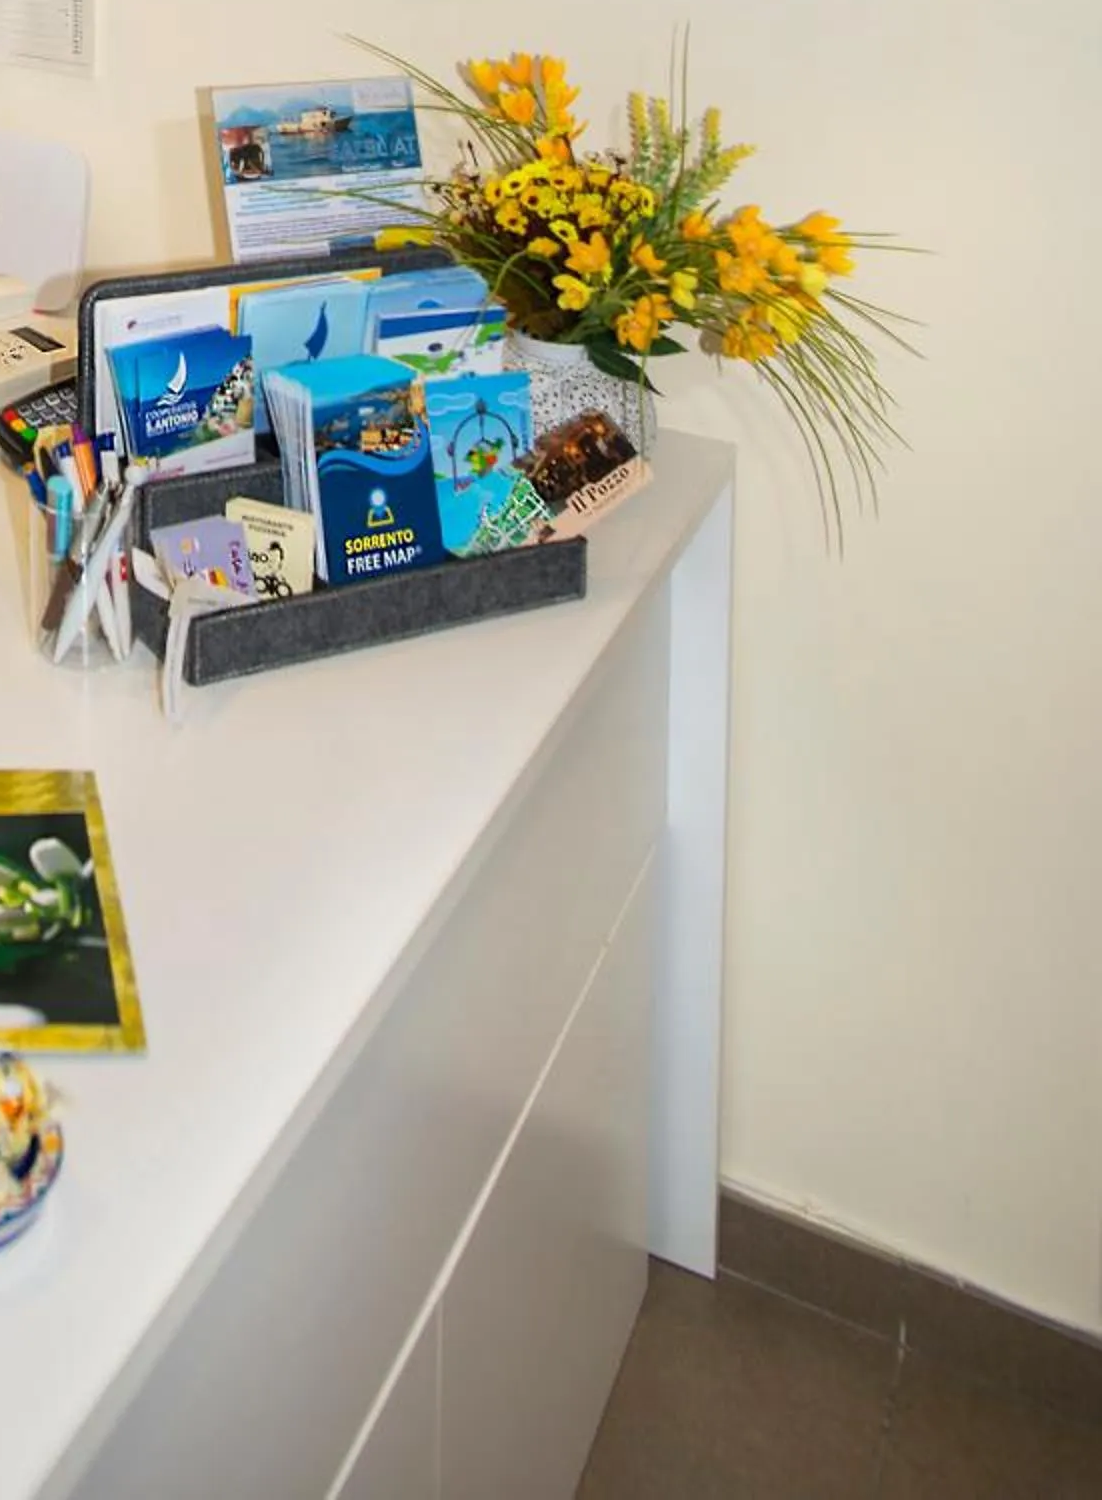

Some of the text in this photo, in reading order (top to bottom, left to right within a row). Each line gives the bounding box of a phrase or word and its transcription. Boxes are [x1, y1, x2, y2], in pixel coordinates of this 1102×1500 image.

[580, 467, 630, 502] Pozzo
[345, 528, 414, 555] SORRENTO
[347, 552, 381, 575] FREE
